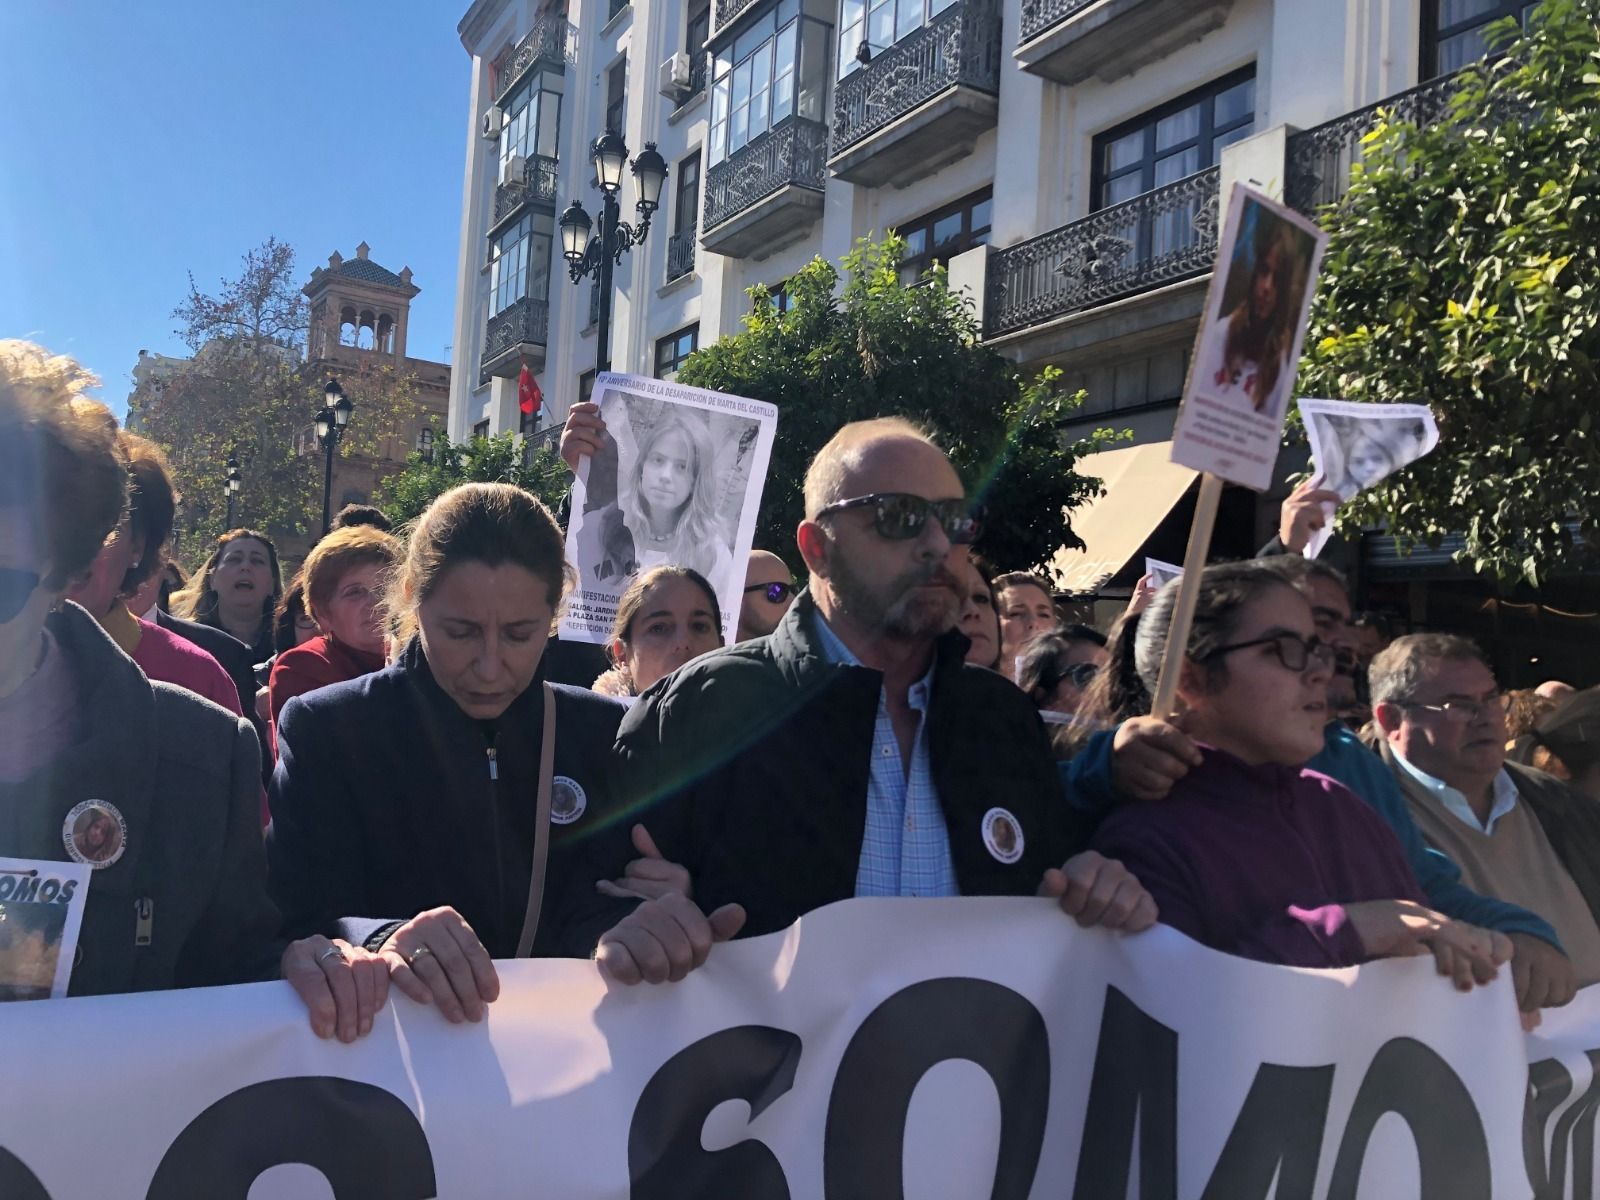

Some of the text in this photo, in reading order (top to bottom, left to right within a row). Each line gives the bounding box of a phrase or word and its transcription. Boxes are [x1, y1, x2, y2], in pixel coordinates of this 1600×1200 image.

[607, 377, 646, 392] ANIVERSARIO
[647, 384, 655, 394] DE
[656, 386, 664, 396] LA
[708, 397, 716, 406] DE
[717, 398, 736, 410] MARTA
[737, 402, 748, 412] DEL
[748, 405, 775, 417] CASTILLO
[573, 612, 594, 621] PLAZA
[594, 614, 608, 622] SAN
[594, 606, 618, 615] JARDIN
[0, 873, 78, 904] OMOS
